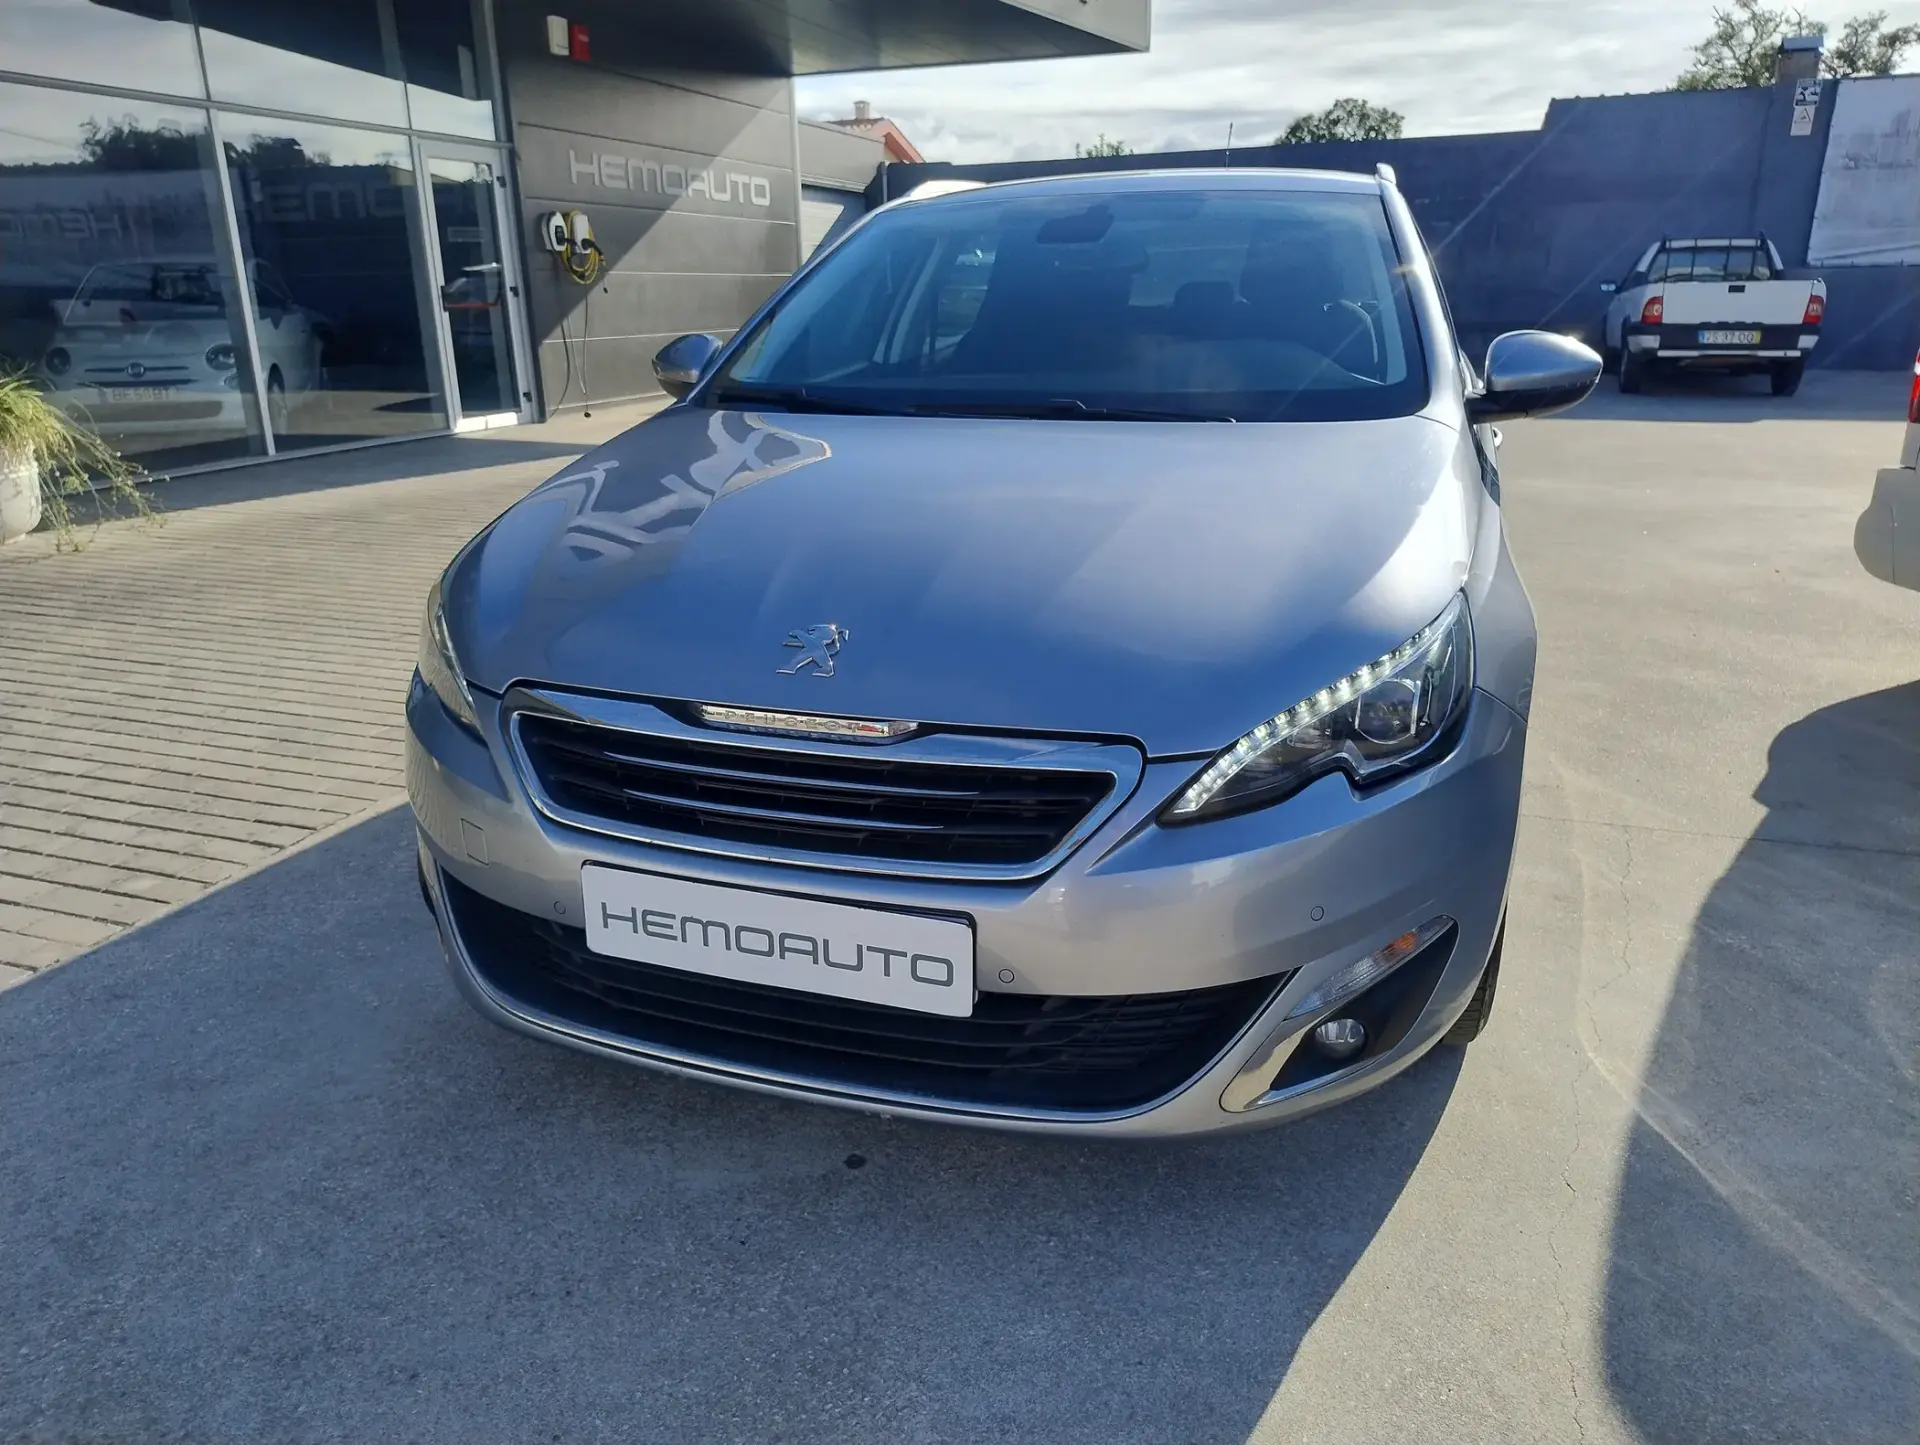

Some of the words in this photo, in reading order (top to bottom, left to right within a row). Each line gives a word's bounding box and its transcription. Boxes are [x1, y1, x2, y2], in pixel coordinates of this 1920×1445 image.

[569, 149, 771, 207] HEMOAUTO
[724, 709, 860, 733] PEUGEOT
[600, 901, 954, 987] HEMOAUTO
